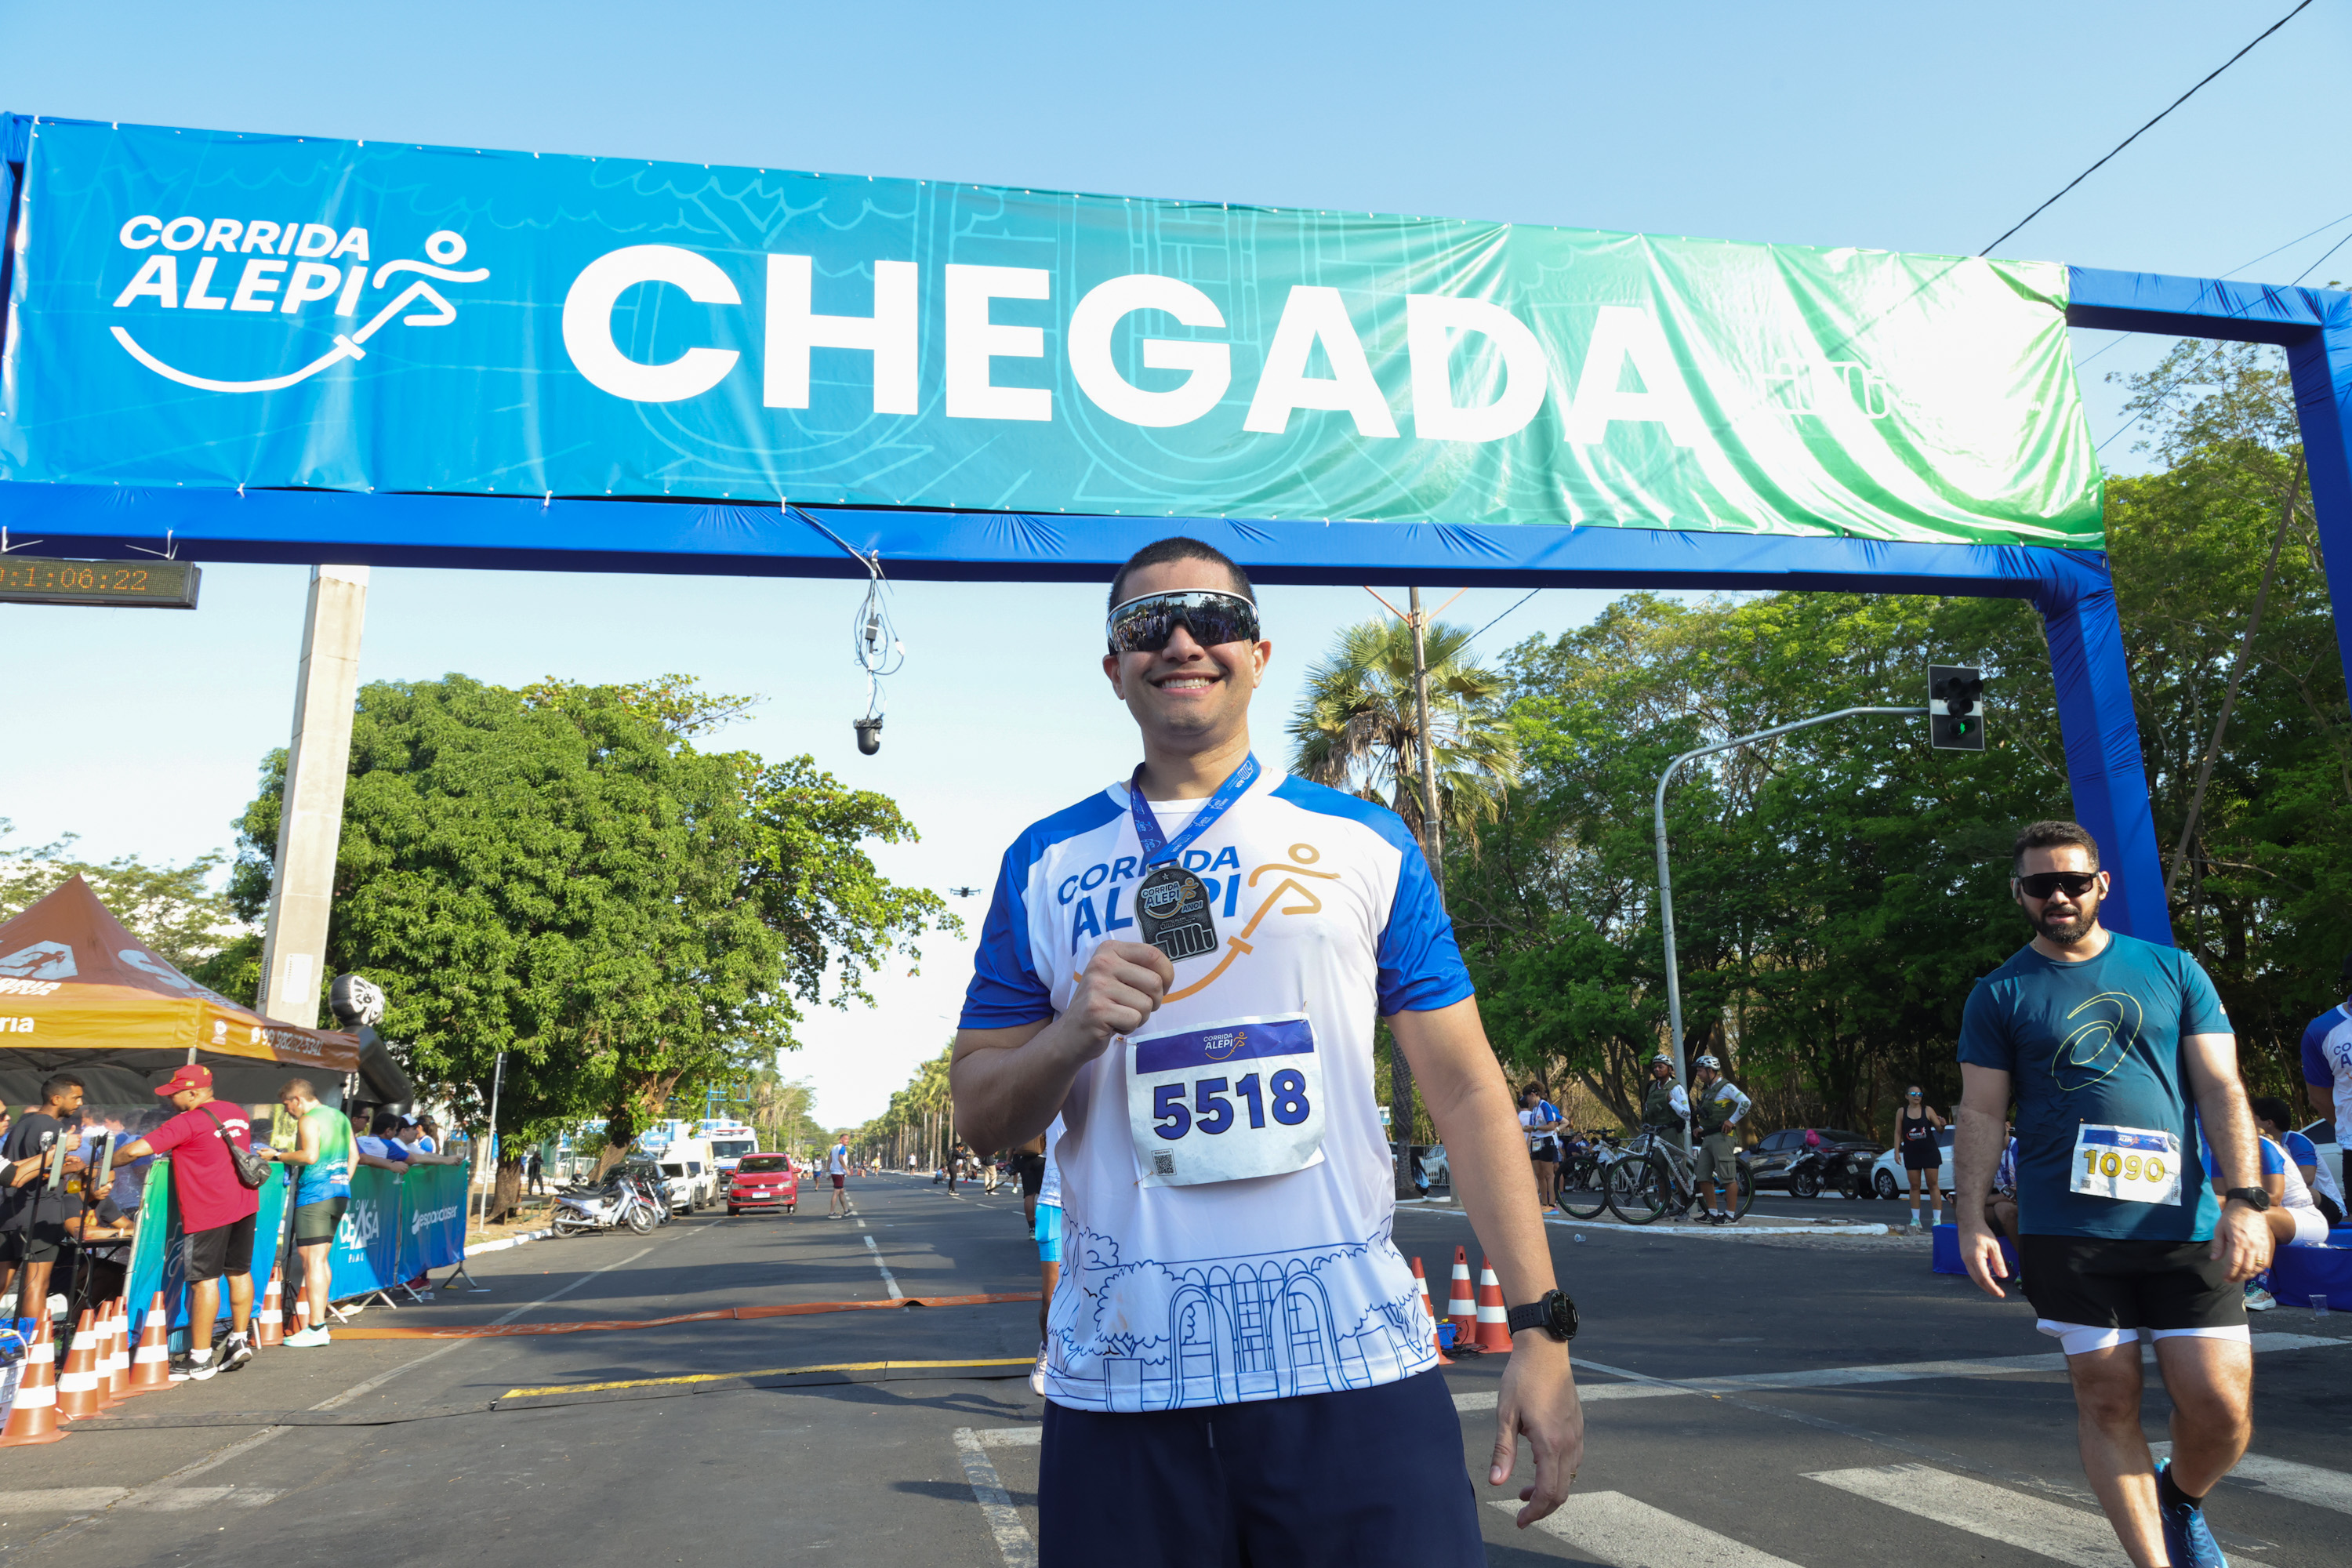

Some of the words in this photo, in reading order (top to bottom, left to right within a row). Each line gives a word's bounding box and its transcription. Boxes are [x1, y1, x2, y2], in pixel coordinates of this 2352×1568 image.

[120, 215, 370, 261] CORRIDA
[113, 255, 368, 317] ALEPI
[562, 245, 1695, 448] CHEGADA
[0, 566, 148, 590] :1:06:22
[1058, 846, 1241, 906] CORDA
[1142, 881, 1179, 897] CORRIDA
[1071, 873, 1241, 958] ALI
[1145, 889, 1180, 909] ALEPI
[0, 977, 62, 990] ORIA
[1203, 1033, 1233, 1043] CORRIDA
[1204, 1039, 1234, 1051] ALEPI
[1153, 1069, 1310, 1141] 5518
[2084, 1149, 2165, 1182] 1090
[339, 1210, 379, 1250] CEASA
